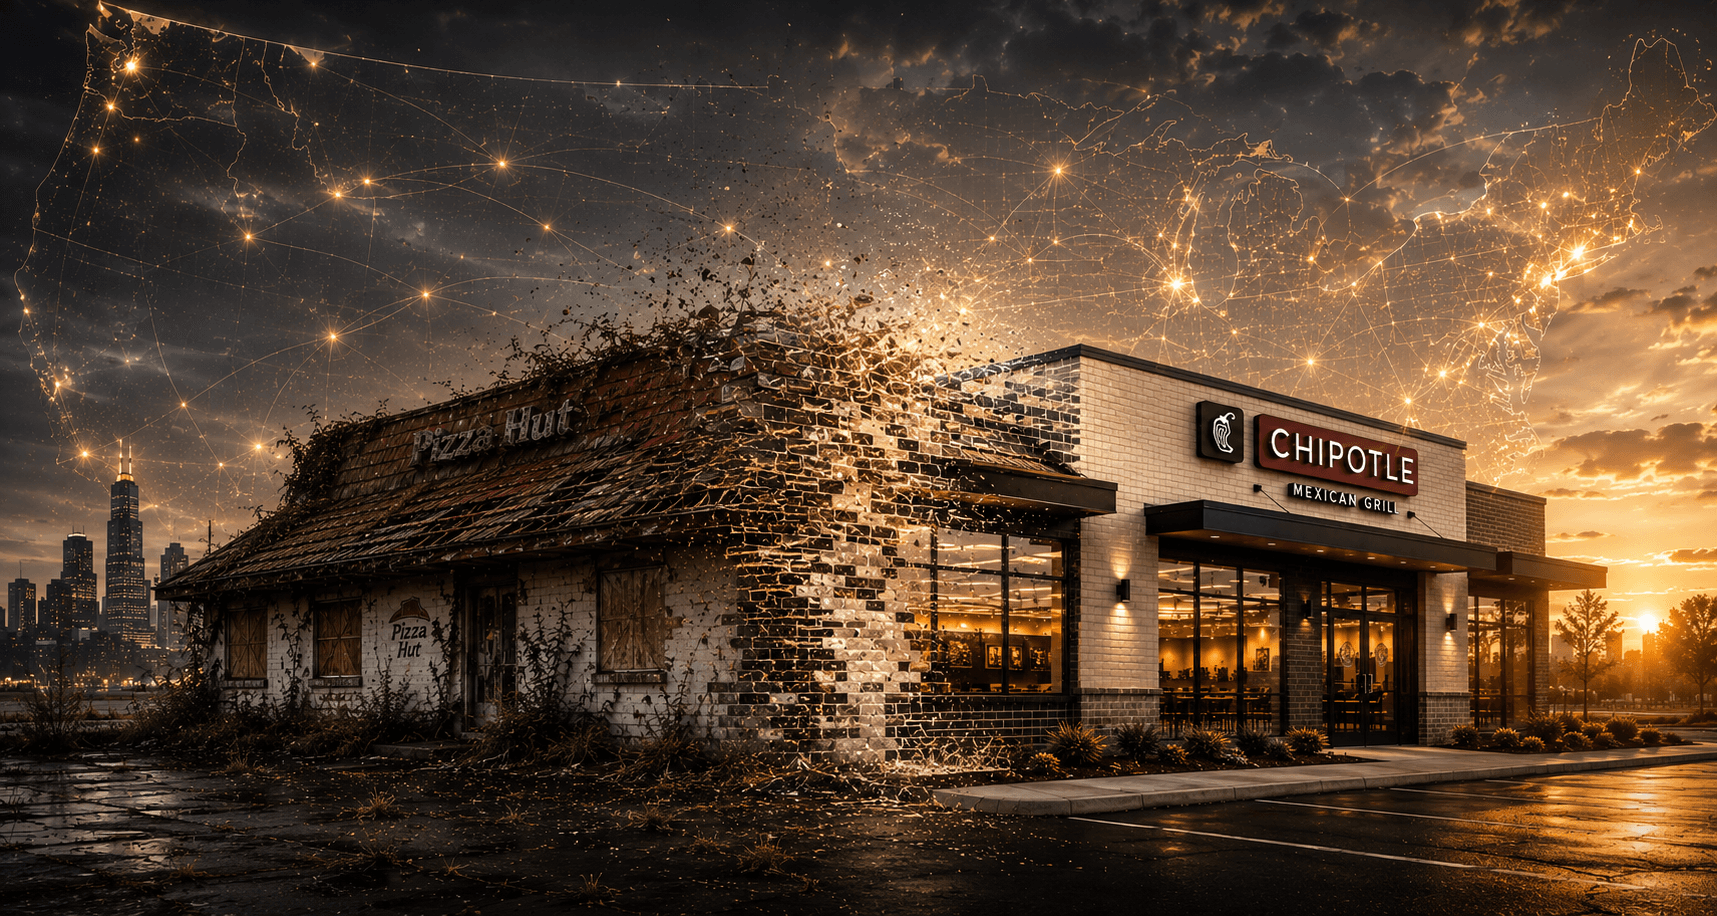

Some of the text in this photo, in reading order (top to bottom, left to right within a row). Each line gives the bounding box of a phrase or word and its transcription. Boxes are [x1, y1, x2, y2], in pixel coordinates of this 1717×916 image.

[410, 399, 573, 466] Pizza Hut
[1271, 428, 1414, 484] CHIPOTLE
[1293, 483, 1400, 515] MEXICAN GRILL
[391, 621, 427, 641] Pizza
[397, 641, 422, 658] Hut
